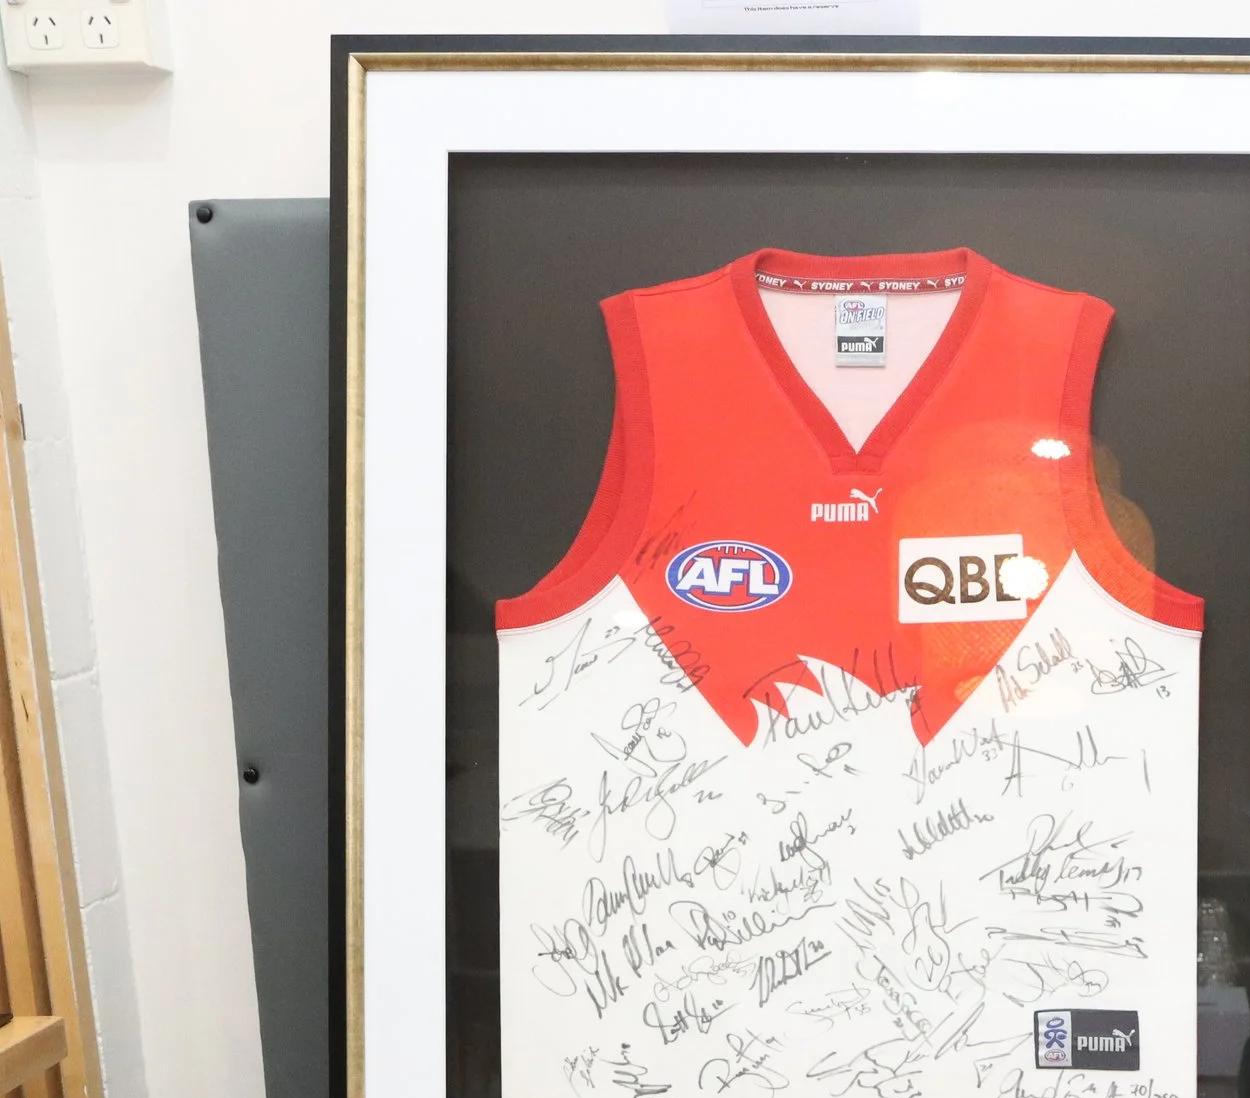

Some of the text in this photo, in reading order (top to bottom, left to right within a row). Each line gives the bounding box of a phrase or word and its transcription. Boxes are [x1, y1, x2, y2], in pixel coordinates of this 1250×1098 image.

[811, 281, 854, 291] SYDNEY
[878, 281, 921, 290] SYDNEY
[944, 275, 967, 287] SYD
[840, 306, 885, 324] ON FIELD
[841, 342, 873, 352] PUMA
[810, 502, 870, 522] PUMA
[675, 556, 781, 597] AFL
[1077, 1036, 1126, 1052] PUMA
